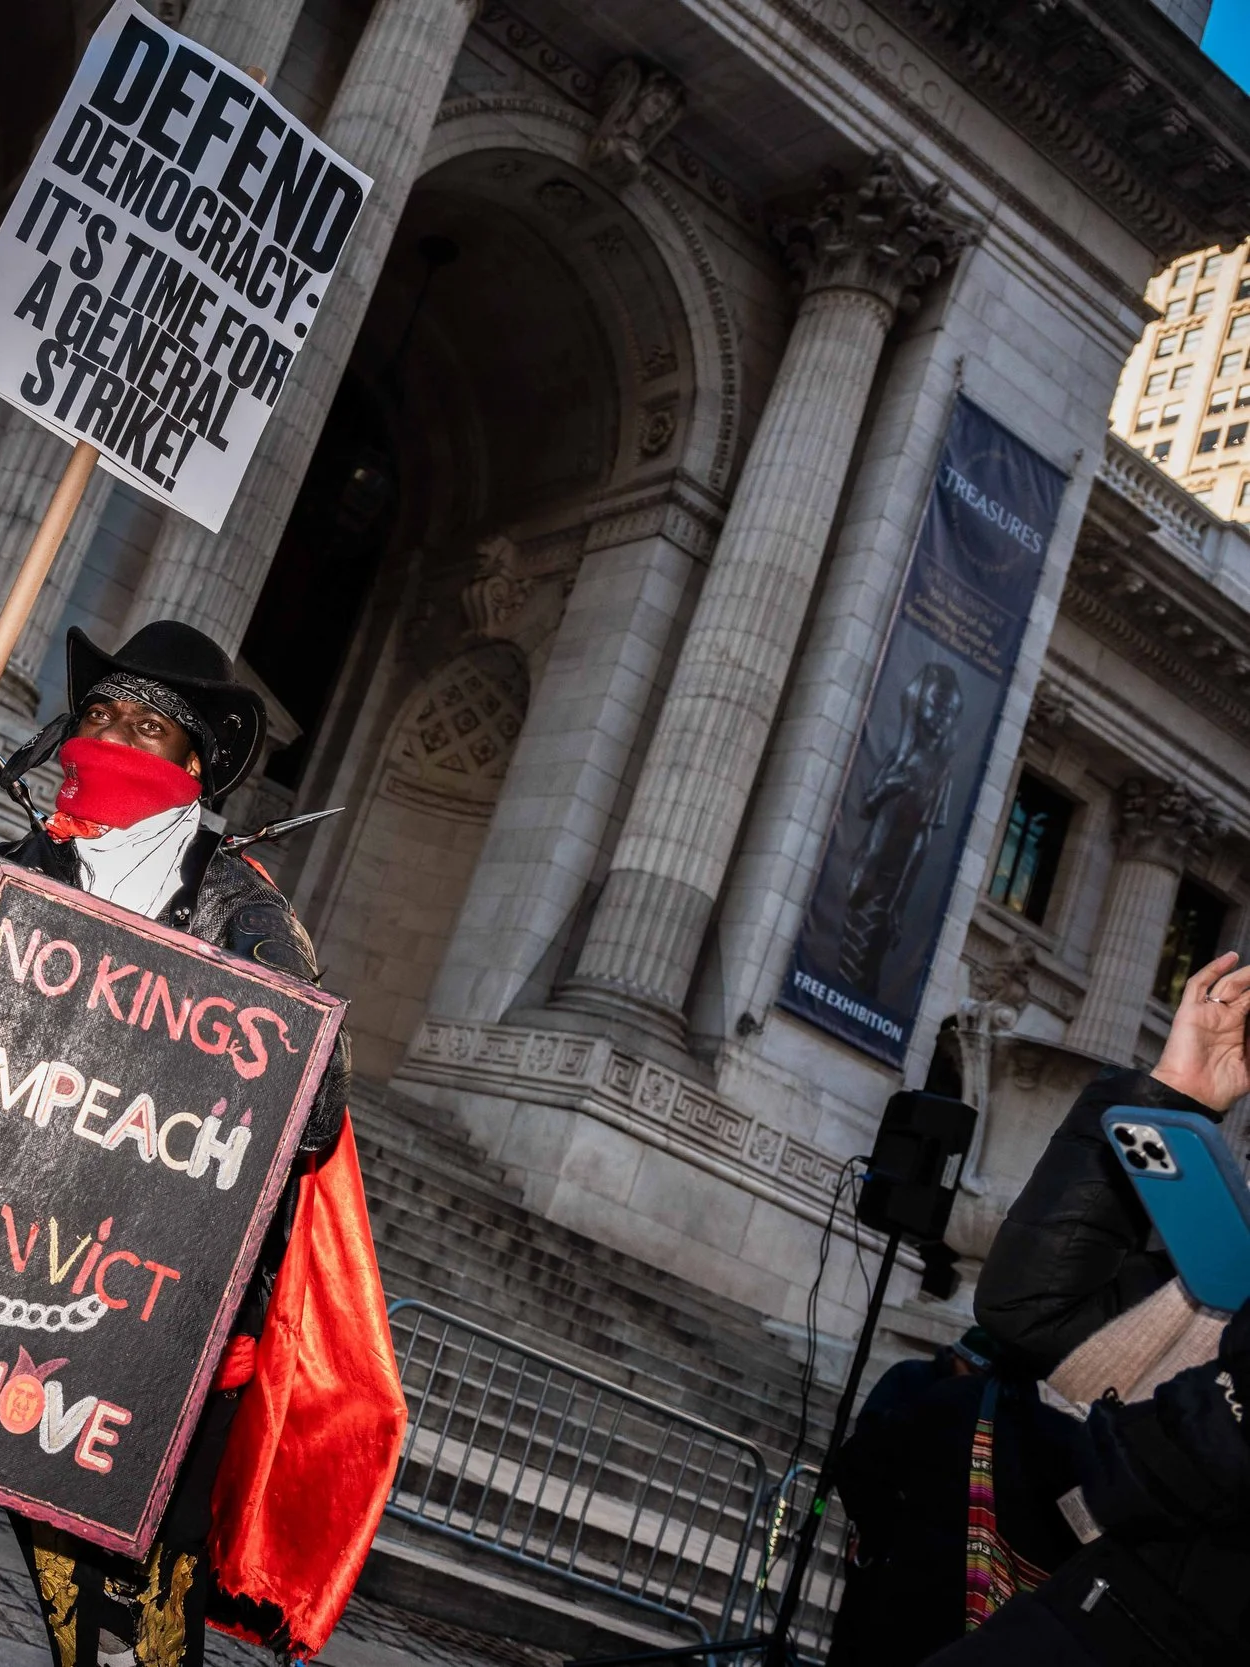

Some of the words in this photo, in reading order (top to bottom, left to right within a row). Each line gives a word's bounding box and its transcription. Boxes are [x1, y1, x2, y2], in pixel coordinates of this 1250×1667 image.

[52, 104, 320, 339] DEMOCRACY:
[88, 13, 364, 274] DEFEND
[13, 260, 62, 331] A
[55, 283, 240, 452] GENERAL
[15, 178, 117, 281] IT'S
[109, 232, 219, 351] TIME
[203, 310, 294, 408] FOR
[20, 338, 197, 493] STRIKE!
[944, 465, 1044, 554] TREASURES
[89, 954, 299, 1080] KINGS
[794, 971, 827, 1001] FREE
[825, 990, 903, 1042] EXHIBITION
